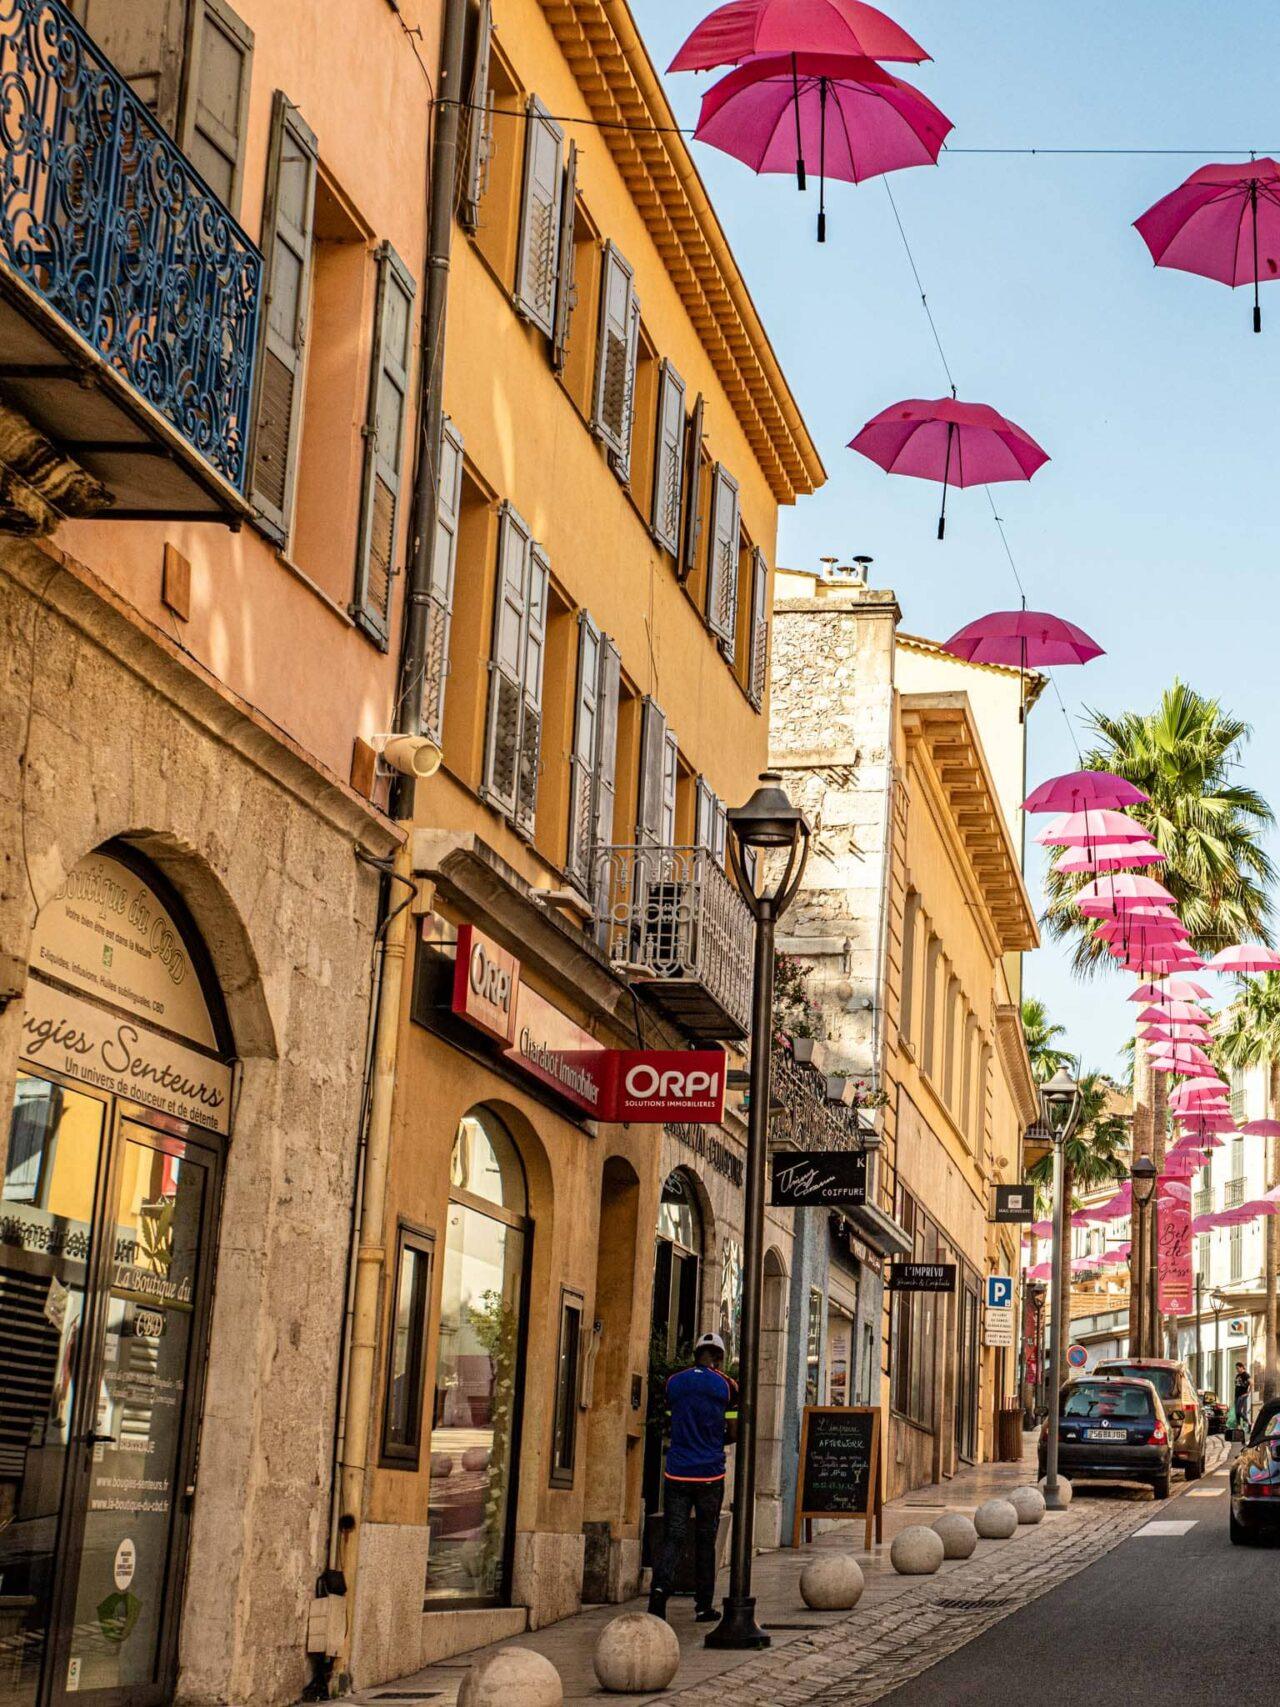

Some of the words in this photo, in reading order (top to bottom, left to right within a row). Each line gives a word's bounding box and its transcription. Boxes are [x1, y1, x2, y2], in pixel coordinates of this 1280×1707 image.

[151, 917, 186, 984] CBD
[470, 943, 510, 1013] ORPI
[152, 1001, 165, 1014] CBD
[101, 1025, 224, 1108] Senteurs
[520, 1027, 558, 1077] Charabot
[560, 1054, 599, 1105] Immobilier
[625, 1064, 718, 1098] ORPI
[65, 1056, 79, 1076] Un
[81, 1066, 114, 1090] univers
[117, 1080, 128, 1094] de
[130, 1083, 166, 1106] douceur
[168, 1098, 175, 1111] et
[177, 1101, 188, 1116] de
[190, 1107, 219, 1129] détente
[857, 1158, 865, 1168] K
[822, 1188, 864, 1197] COIFFURE
[113, 1265, 130, 1287] La
[132, 1269, 176, 1304] Boutique
[177, 1277, 190, 1301] du
[994, 1282, 1006, 1302] P
[136, 1313, 163, 1337] CBD
[819, 1439, 865, 1448] AFTERWORK
